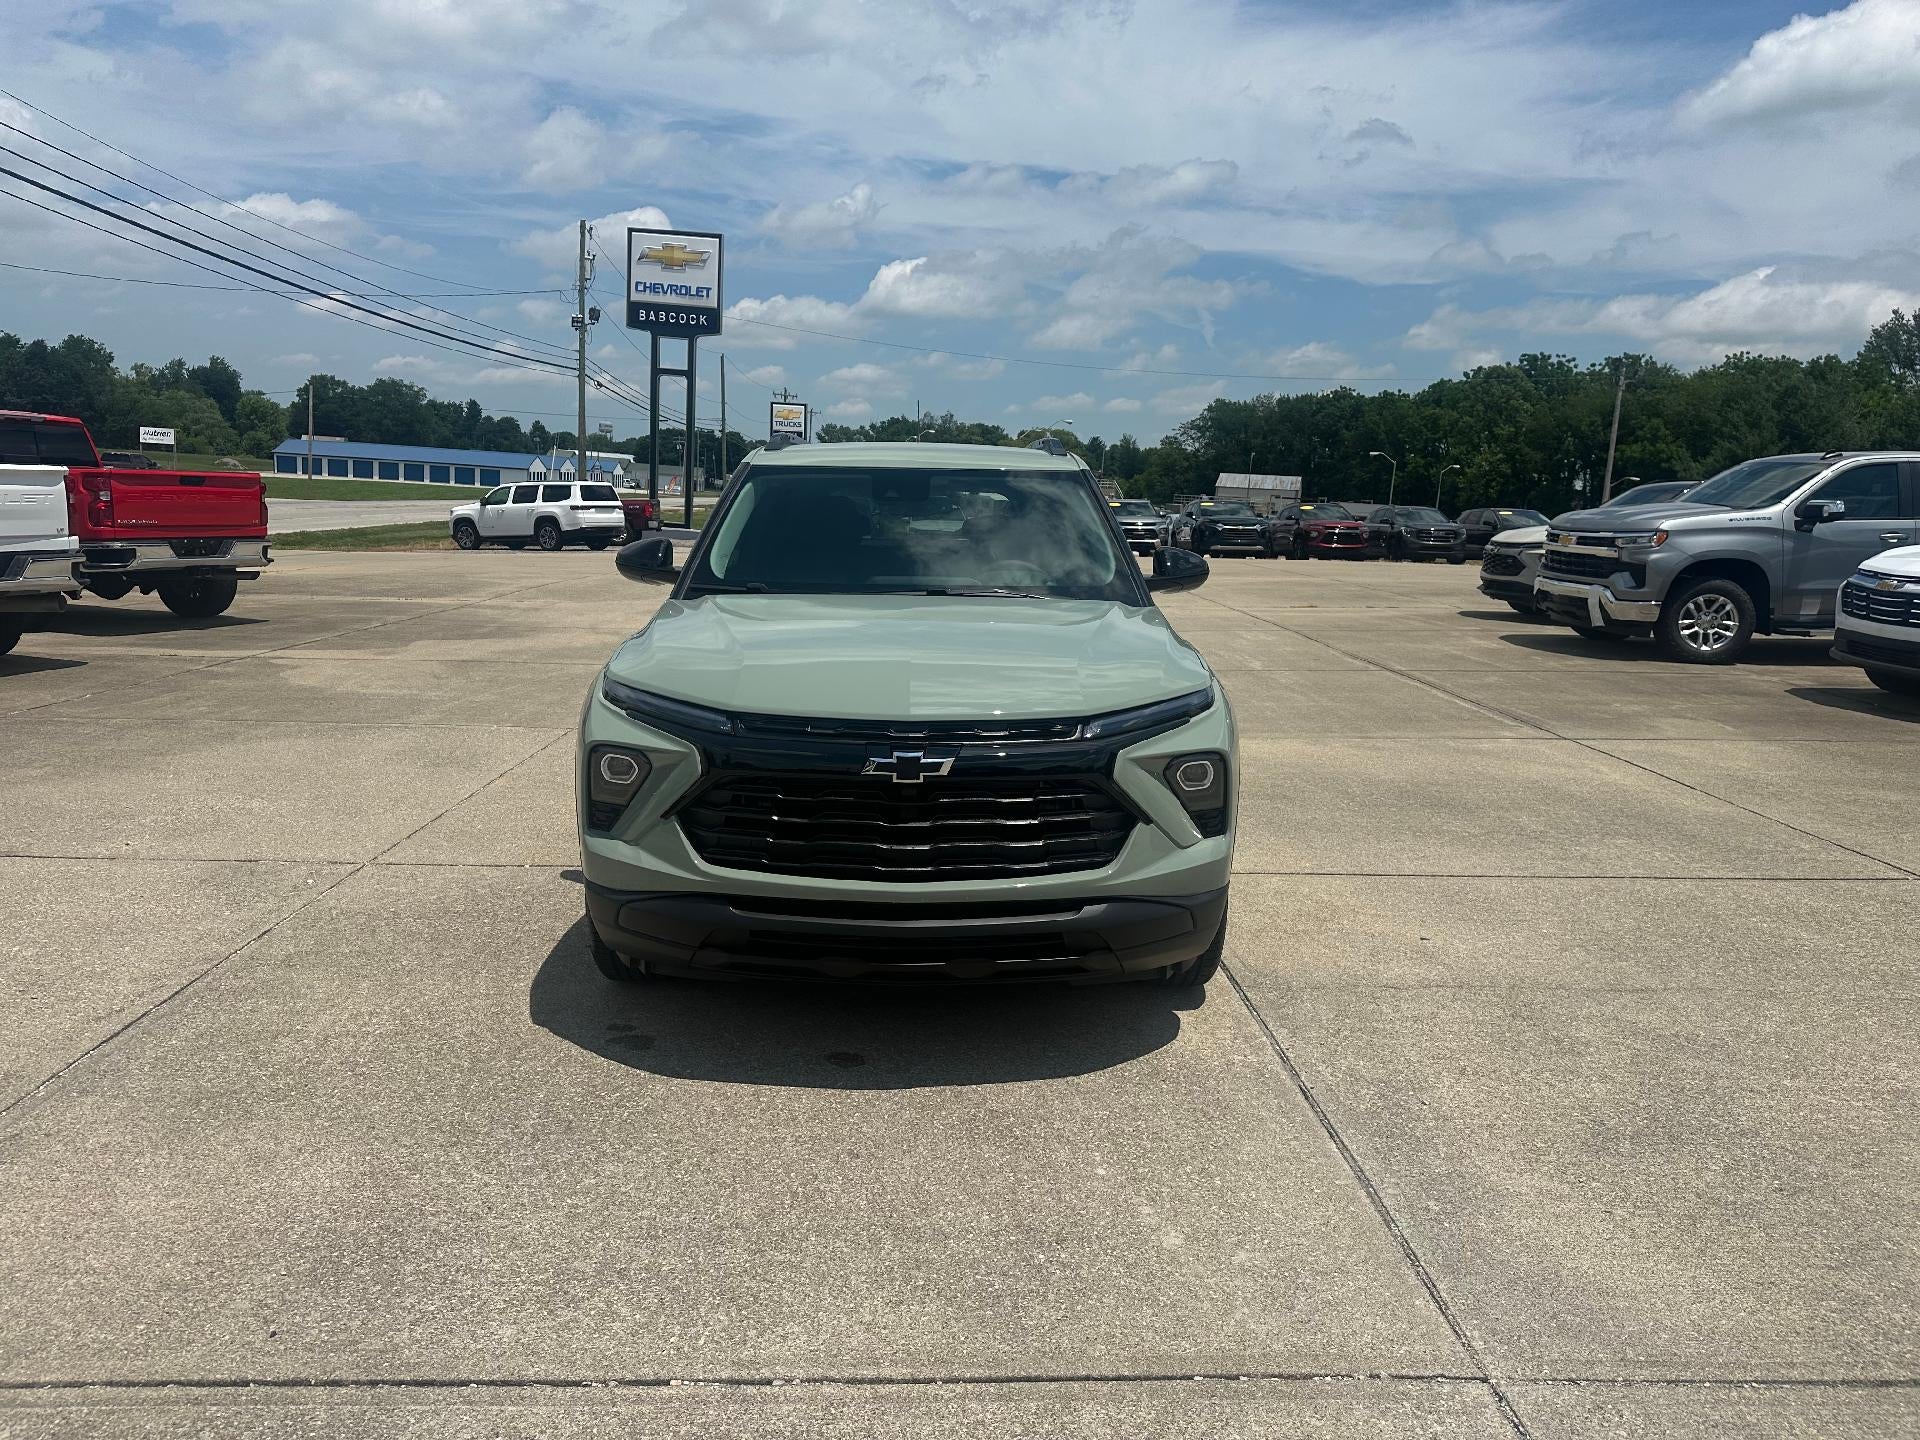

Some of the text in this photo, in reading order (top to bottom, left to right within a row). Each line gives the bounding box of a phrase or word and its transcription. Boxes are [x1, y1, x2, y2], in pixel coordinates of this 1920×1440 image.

[635, 281, 712, 298] CHEVROLET
[639, 310, 708, 326] BABCOCK
[774, 420, 803, 428] TRUCKS
[0, 493, 55, 505] LET
